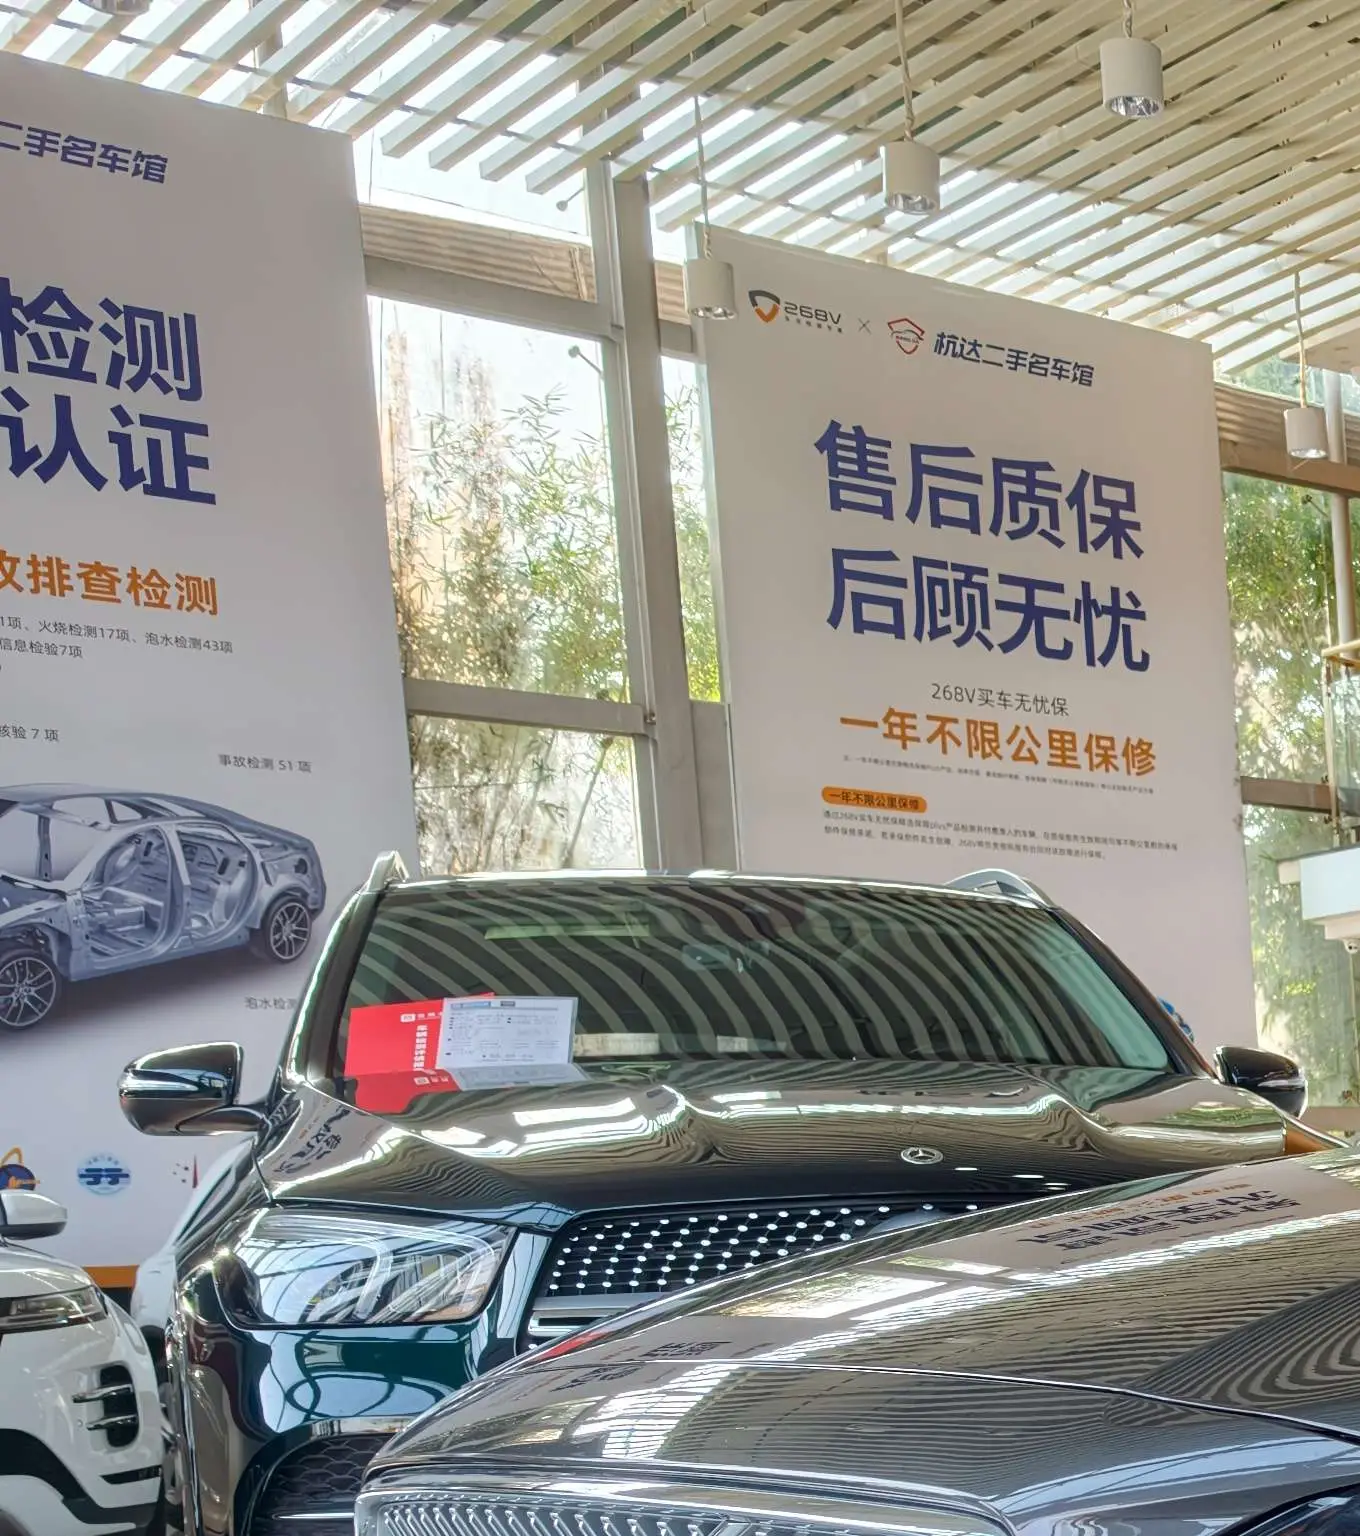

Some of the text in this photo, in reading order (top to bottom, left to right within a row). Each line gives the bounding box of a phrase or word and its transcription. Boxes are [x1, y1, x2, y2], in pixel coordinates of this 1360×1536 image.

[783, 301, 842, 325] 268V
[933, 331, 1095, 387] 杭达二手名车馆
[0, 386, 216, 505] 认证
[814, 420, 1145, 560] 售后质保
[826, 547, 1150, 672] 后顾无忧
[931, 683, 1070, 716] 268V买车无忧保
[840, 707, 1156, 776] 一年不限公里保修
